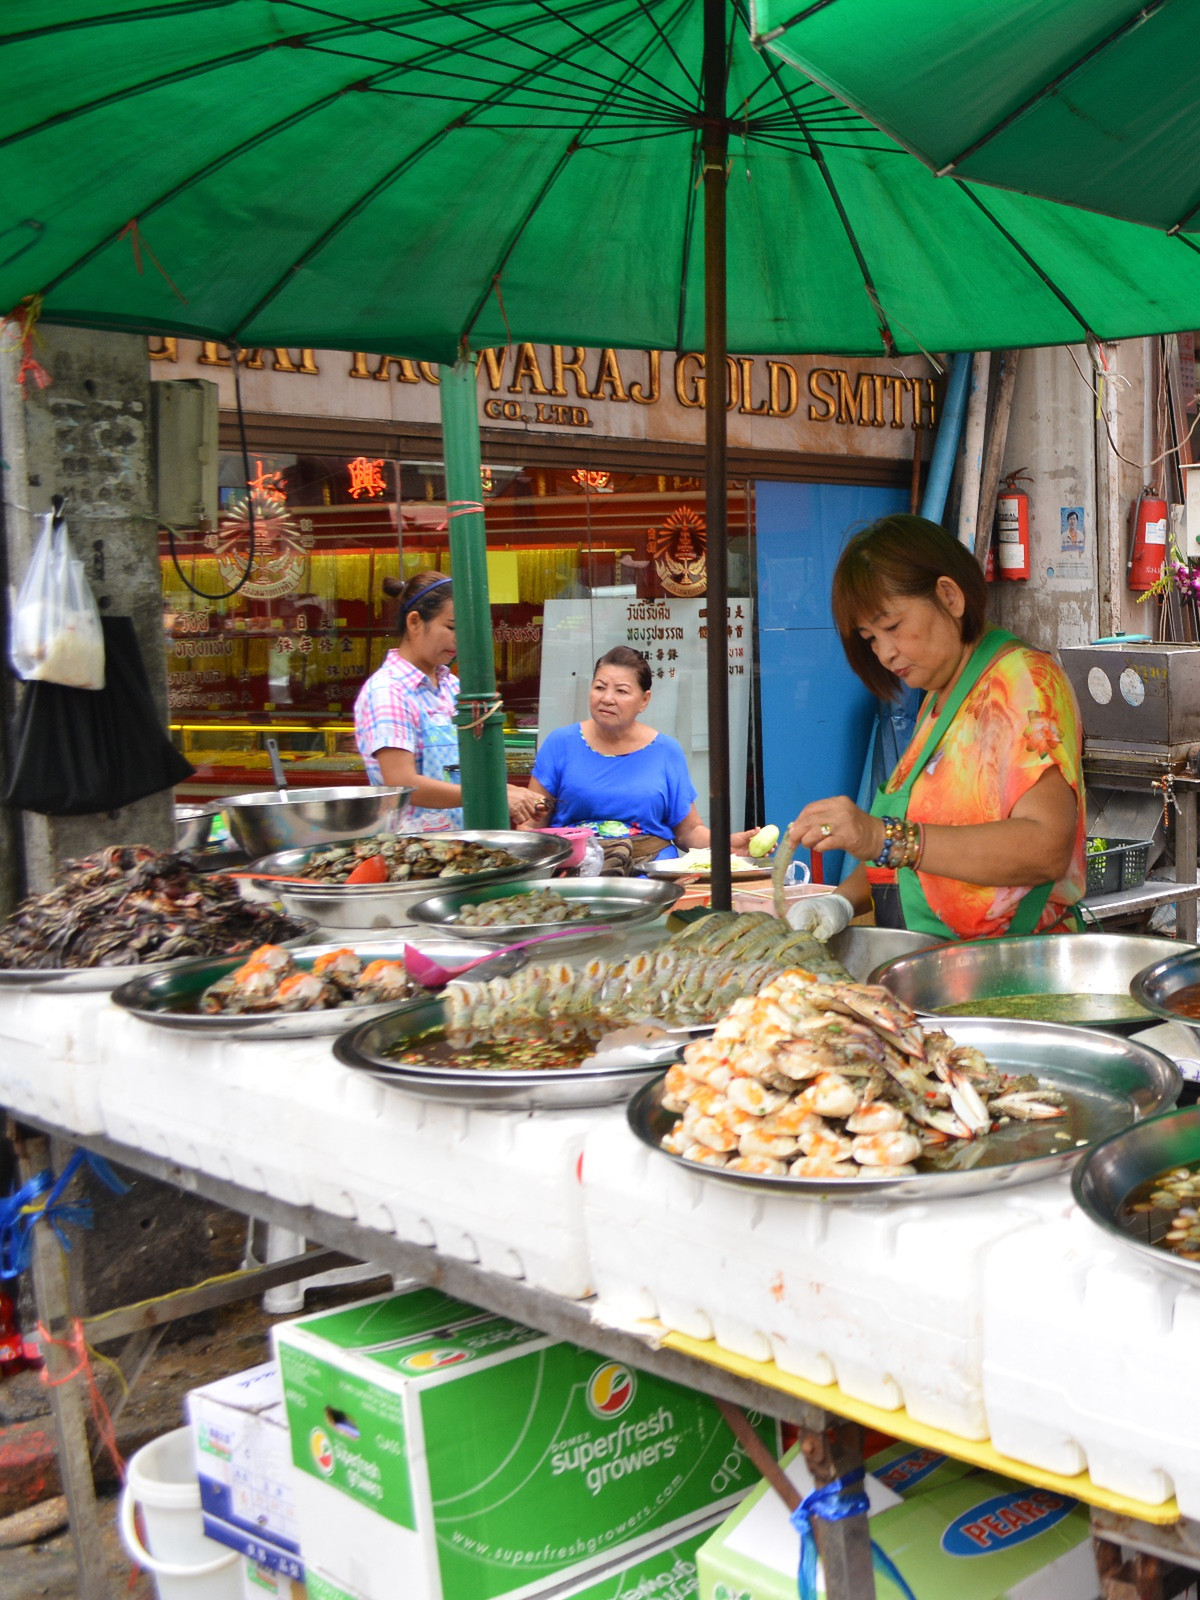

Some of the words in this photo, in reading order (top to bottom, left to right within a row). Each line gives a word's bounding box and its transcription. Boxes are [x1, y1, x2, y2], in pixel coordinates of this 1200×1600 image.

[807, 367, 937, 429] SMITH
[627, 626, 684, 646] ทองรูปพรรณ
[551, 1405, 674, 1476] superfresh
[551, 1431, 592, 1454] DOMEX
[452, 1473, 683, 1566] www.superfreshgrowers.com
[960, 1490, 1064, 1548] PEARS
